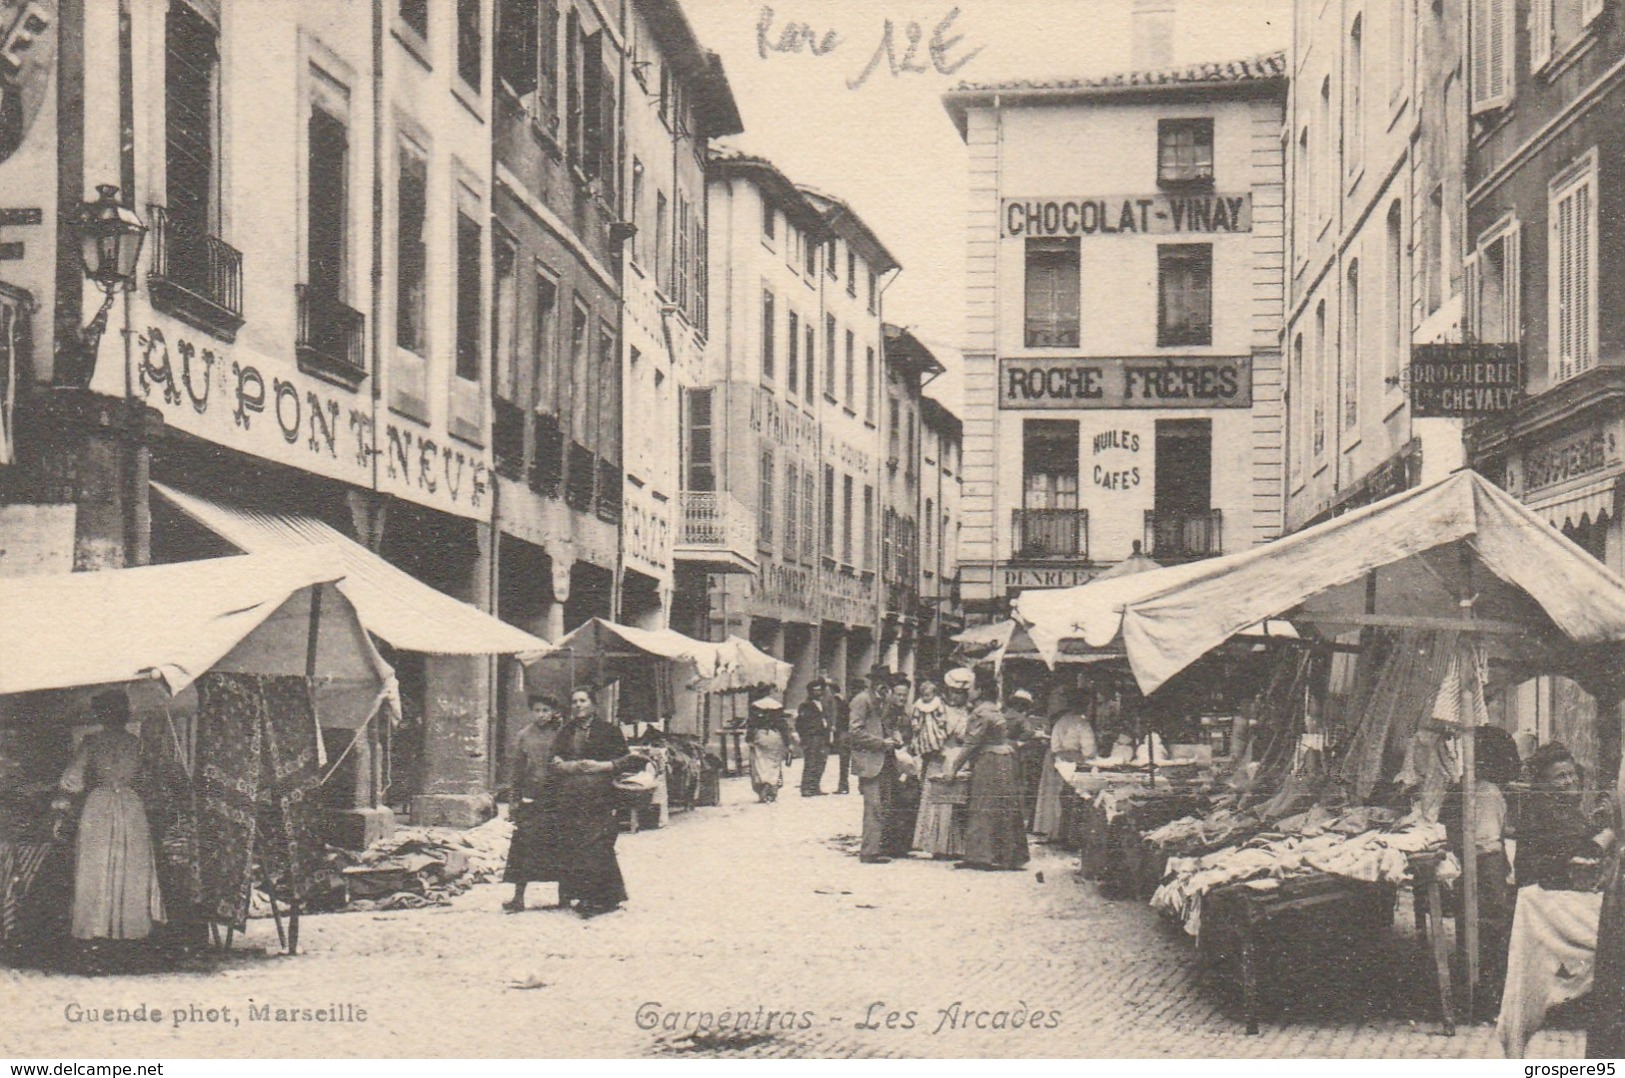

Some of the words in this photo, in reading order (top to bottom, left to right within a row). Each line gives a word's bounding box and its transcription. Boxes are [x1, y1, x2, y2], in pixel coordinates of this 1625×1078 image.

[138, 325, 215, 414] AU
[1007, 366, 1103, 399] ROCHE
[1124, 359, 1238, 399] FRÈRES
[1414, 363, 1511, 383] DROGUERIE
[1093, 430, 1140, 455] HUILES
[1093, 464, 1140, 490] CAFES
